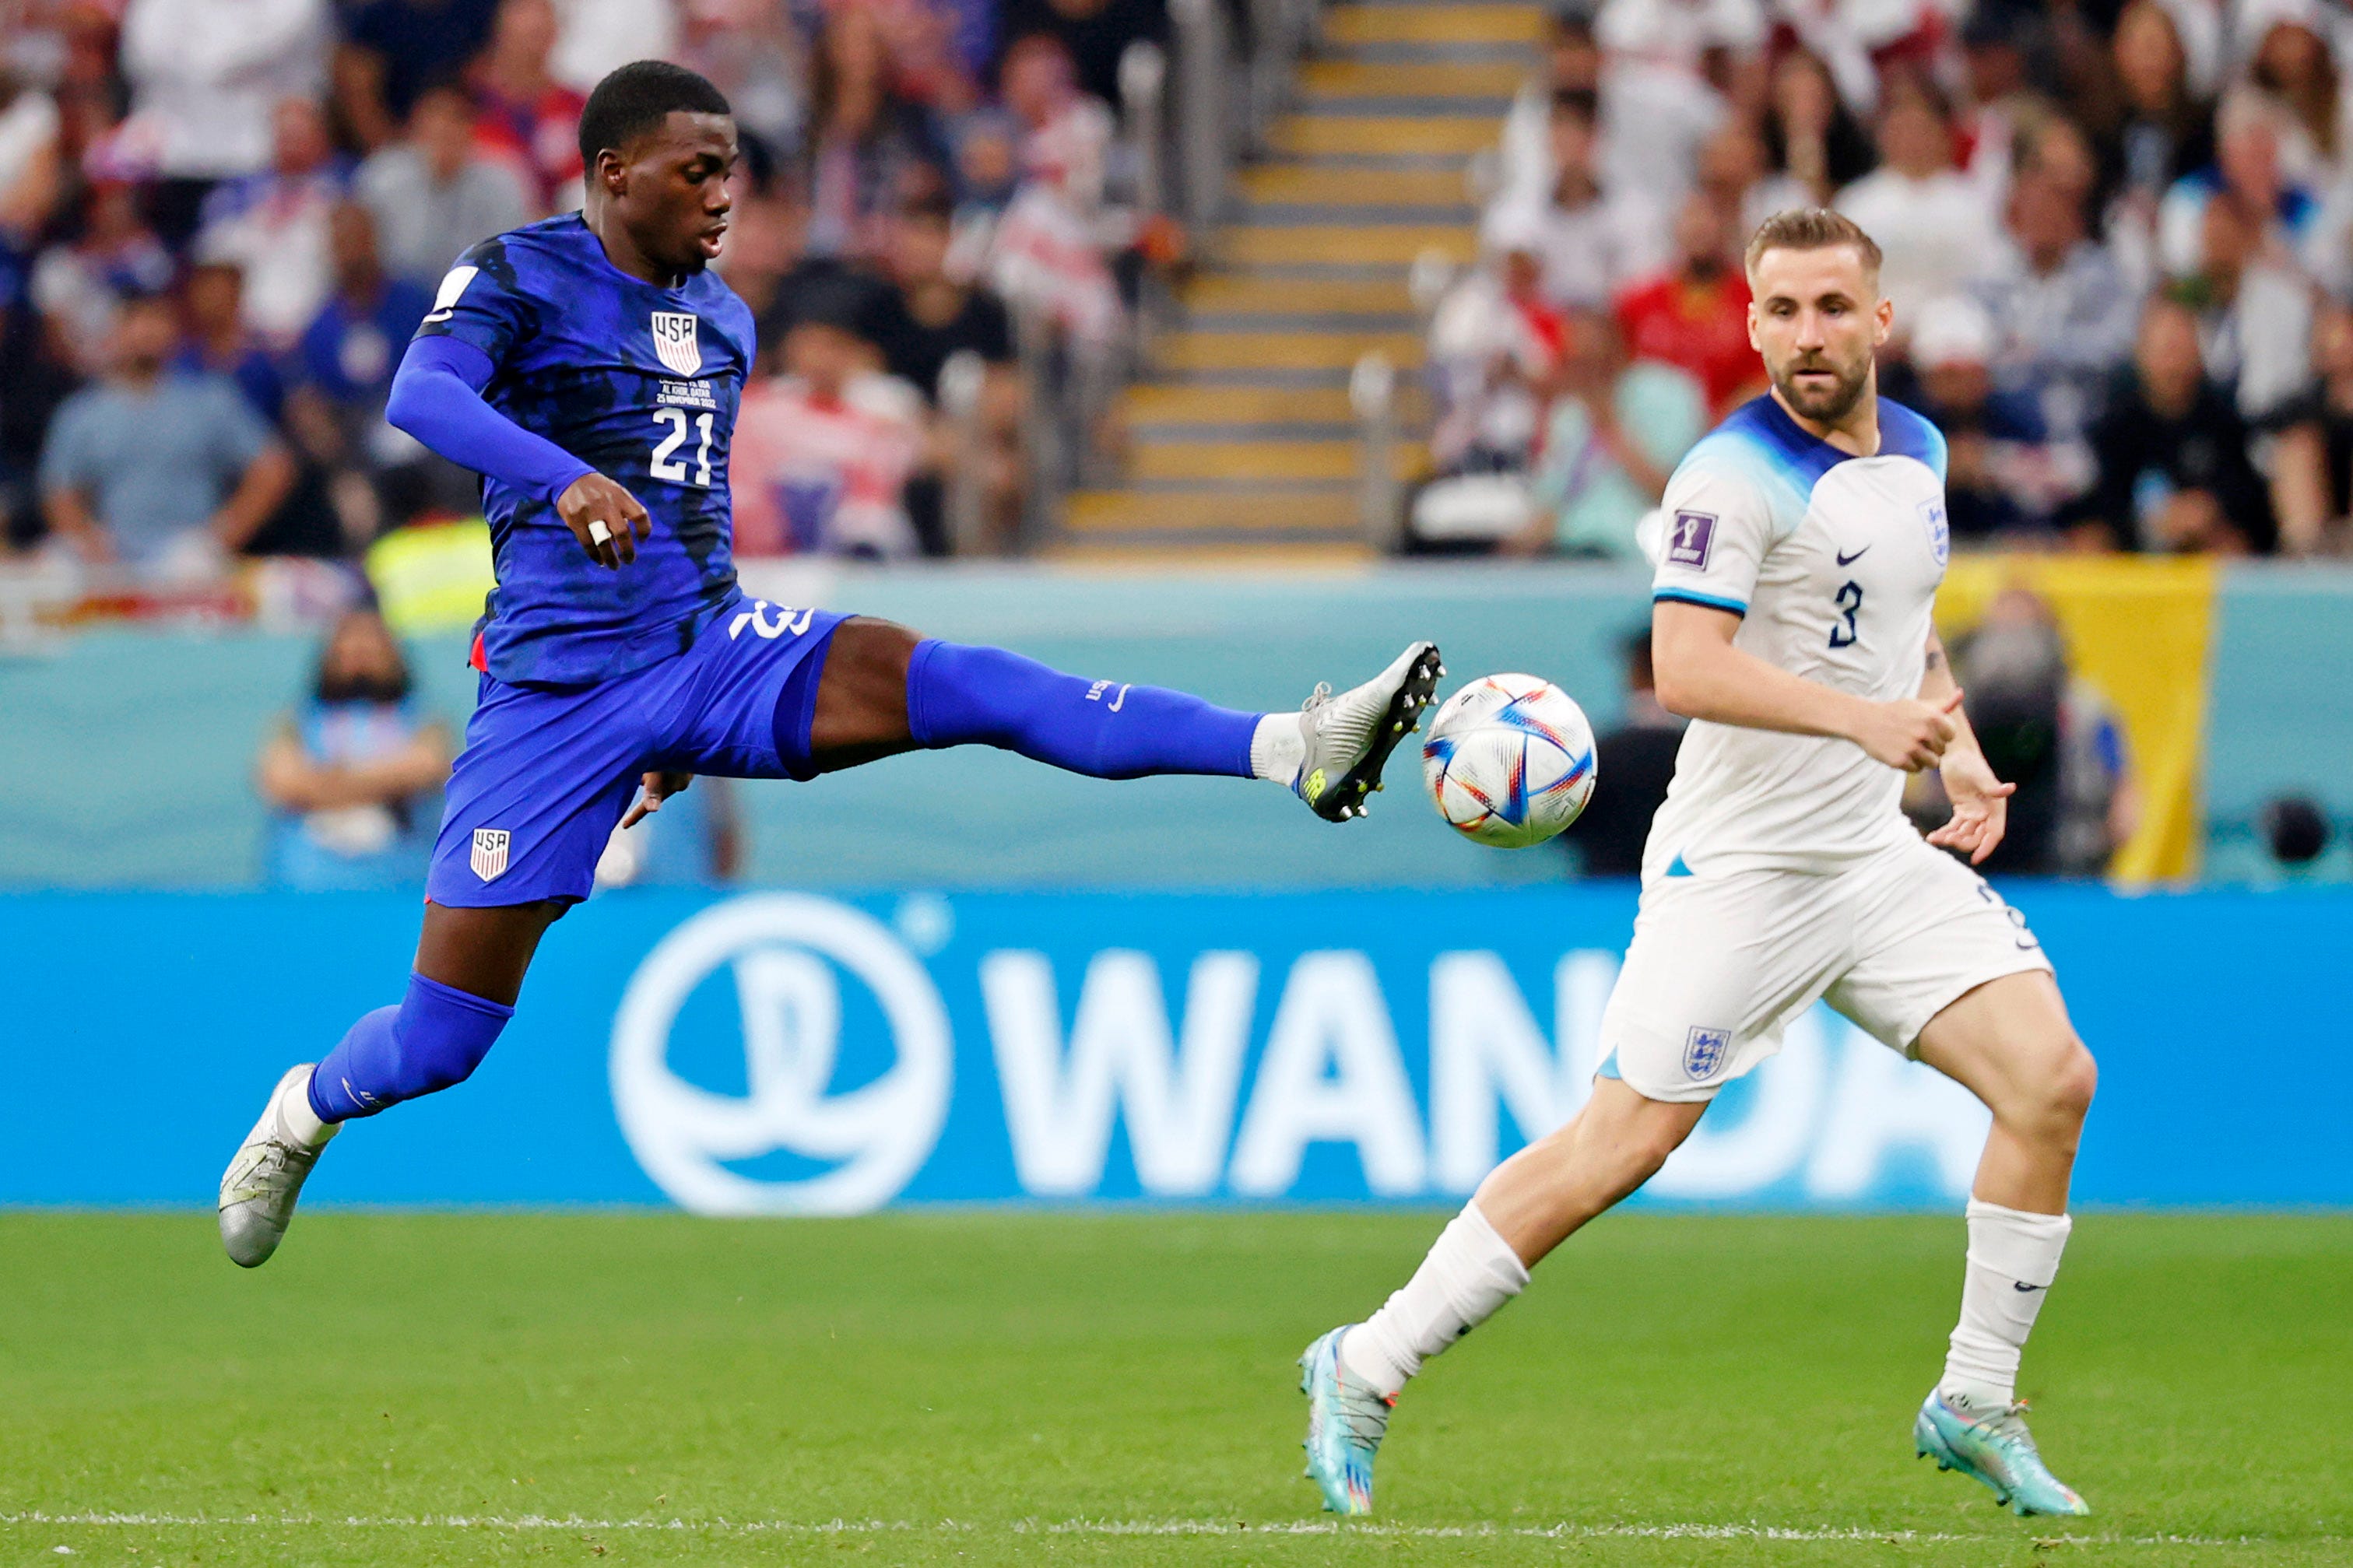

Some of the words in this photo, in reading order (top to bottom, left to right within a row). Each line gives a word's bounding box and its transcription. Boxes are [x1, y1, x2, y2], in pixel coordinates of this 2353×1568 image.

[655, 315, 693, 342] USA
[657, 393, 666, 403] 25
[666, 395, 701, 405] NOVEMBER
[701, 398, 716, 409] 2022
[662, 384, 670, 394] AL
[690, 388, 711, 398] QATAR
[650, 407, 714, 486] 21
[1828, 580, 1863, 648] 3
[476, 831, 507, 851] USA
